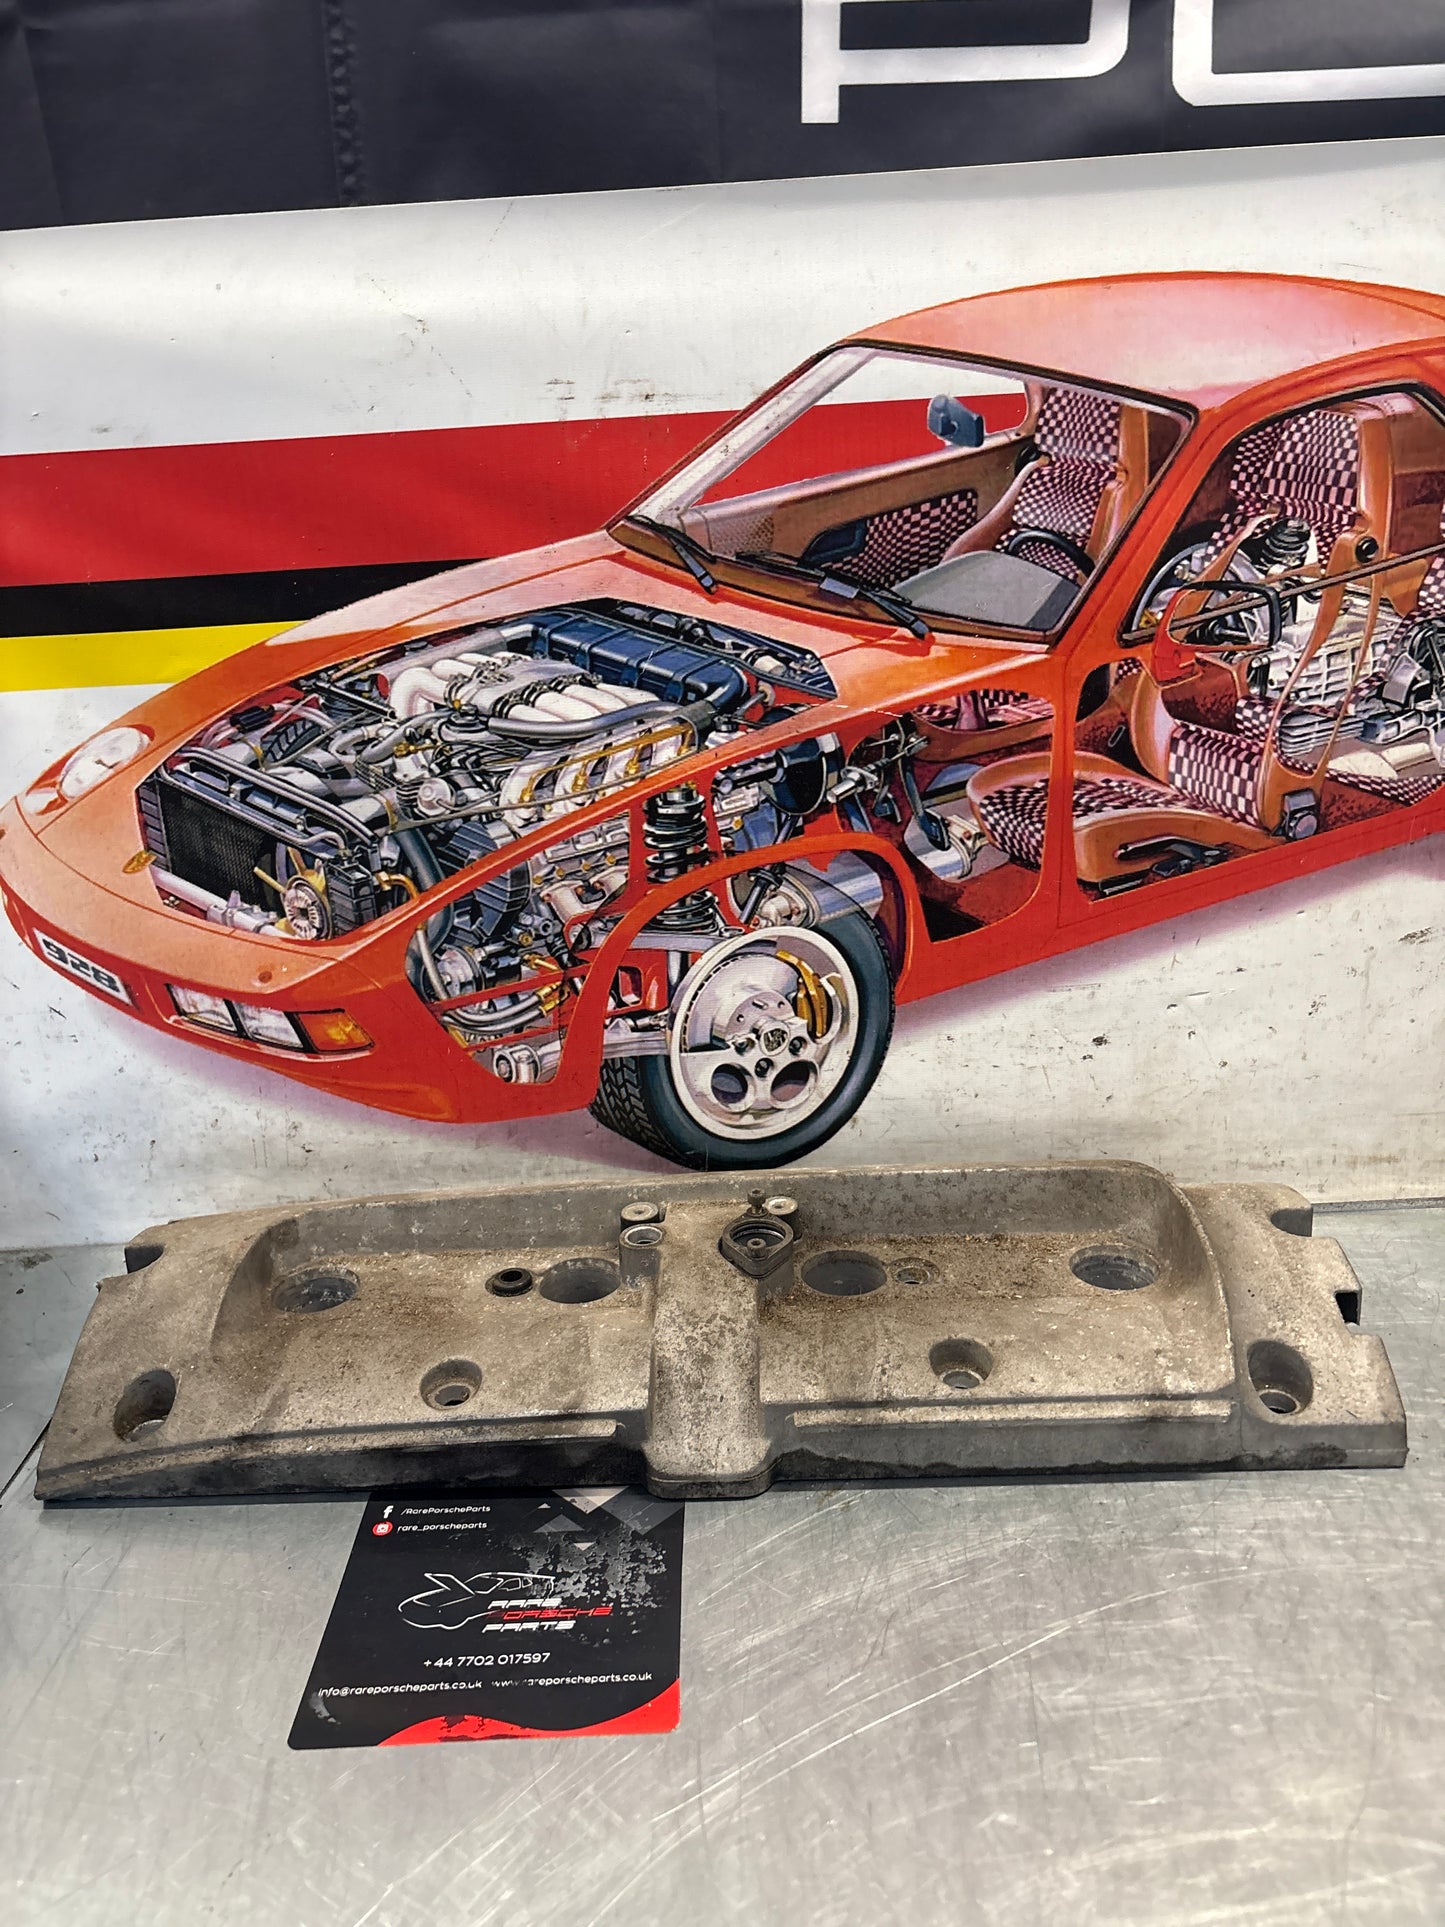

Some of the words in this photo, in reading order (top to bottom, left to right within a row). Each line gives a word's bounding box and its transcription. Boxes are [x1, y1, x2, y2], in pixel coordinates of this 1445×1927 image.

[42, 939, 121, 993] 928
[401, 1505, 491, 1516] /RarePorscheParts
[397, 1521, 488, 1533] rare_porscheparts
[486, 1606, 613, 1620] ORSCHE
[481, 1620, 576, 1633] PARTS
[457, 1655, 495, 1667] 7702
[497, 1652, 551, 1665] 017597
[318, 1680, 482, 1698] info@rareporscheparts.co.uk
